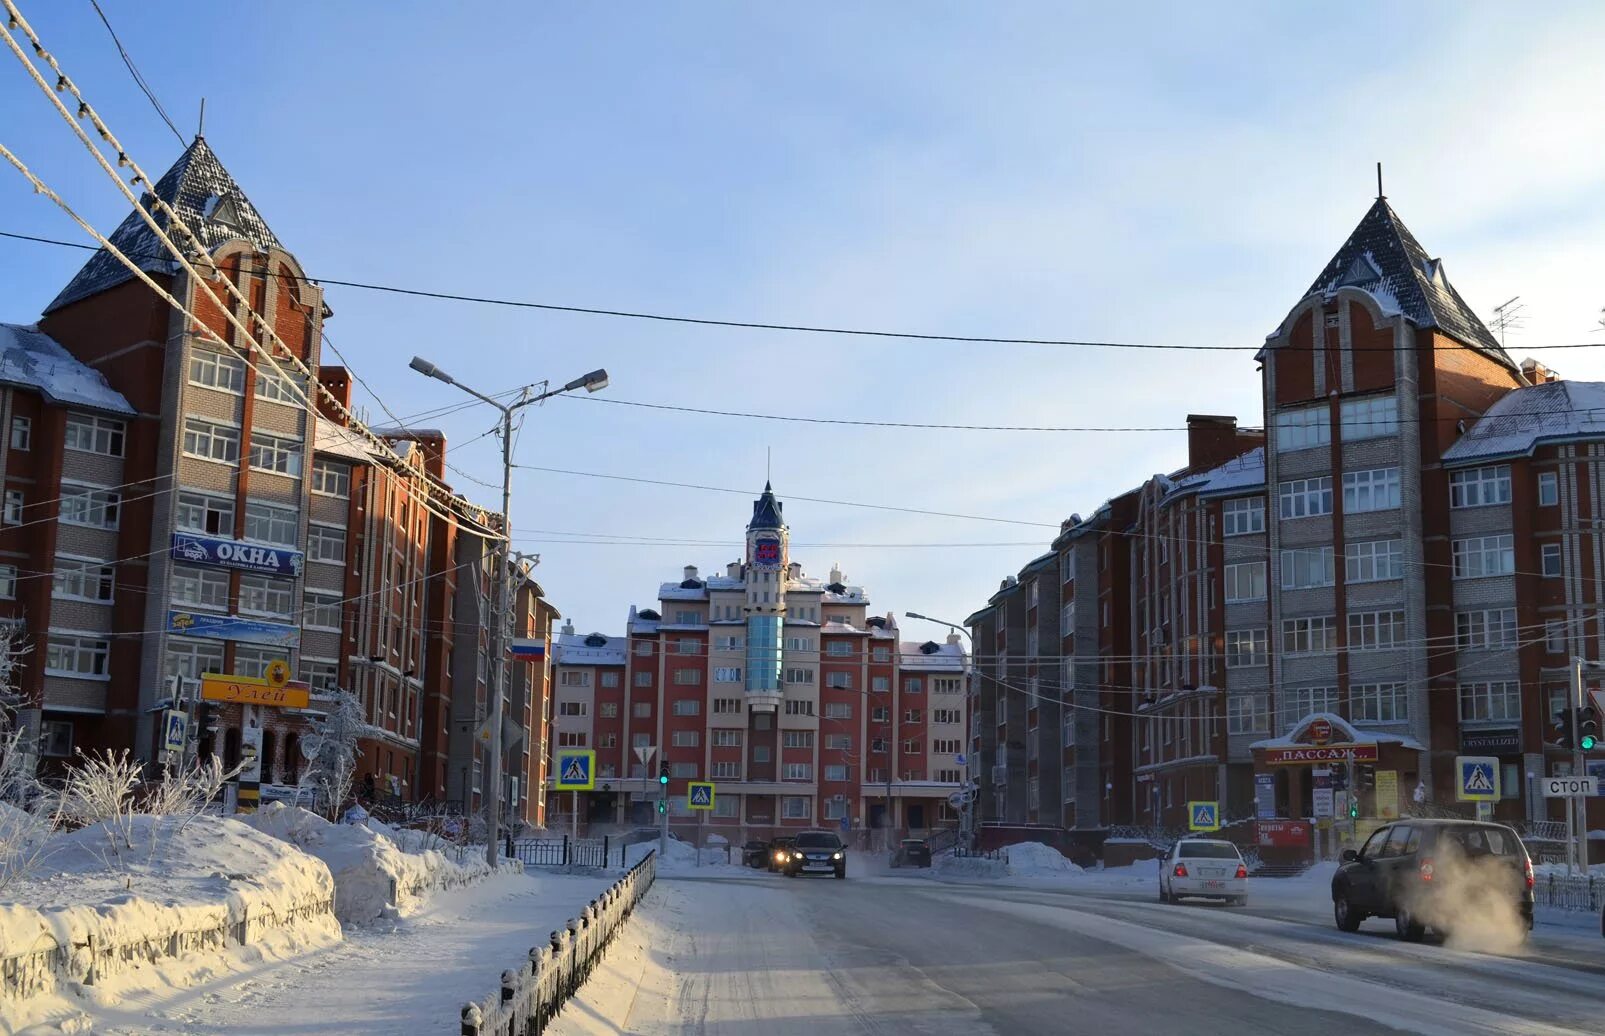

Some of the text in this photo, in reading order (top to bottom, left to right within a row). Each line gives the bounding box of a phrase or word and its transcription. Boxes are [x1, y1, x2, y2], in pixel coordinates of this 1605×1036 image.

[216, 543, 280, 568] ОКНА
[226, 684, 287, 702] Улей
[1463, 738, 1519, 748] CRYSTALLIZED
[1550, 780, 1590, 793] СТОП
